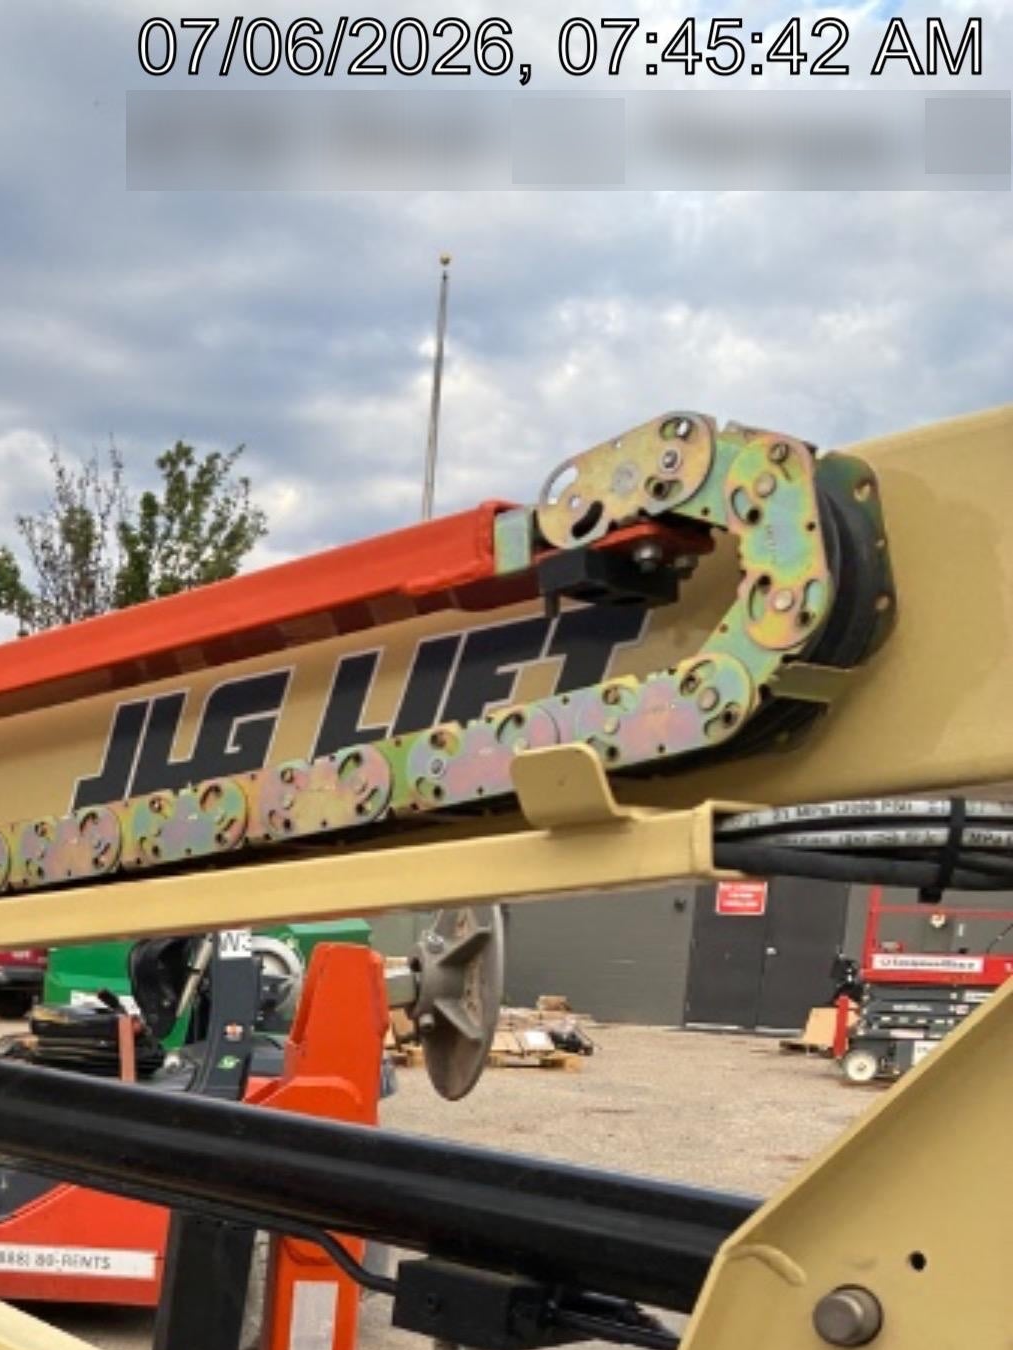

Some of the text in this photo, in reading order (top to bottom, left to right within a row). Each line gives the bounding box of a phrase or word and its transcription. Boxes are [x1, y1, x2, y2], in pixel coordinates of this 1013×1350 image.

[70, 602, 651, 813] JLG LIFT
[34, 1251, 113, 1271] 80-RENTS
